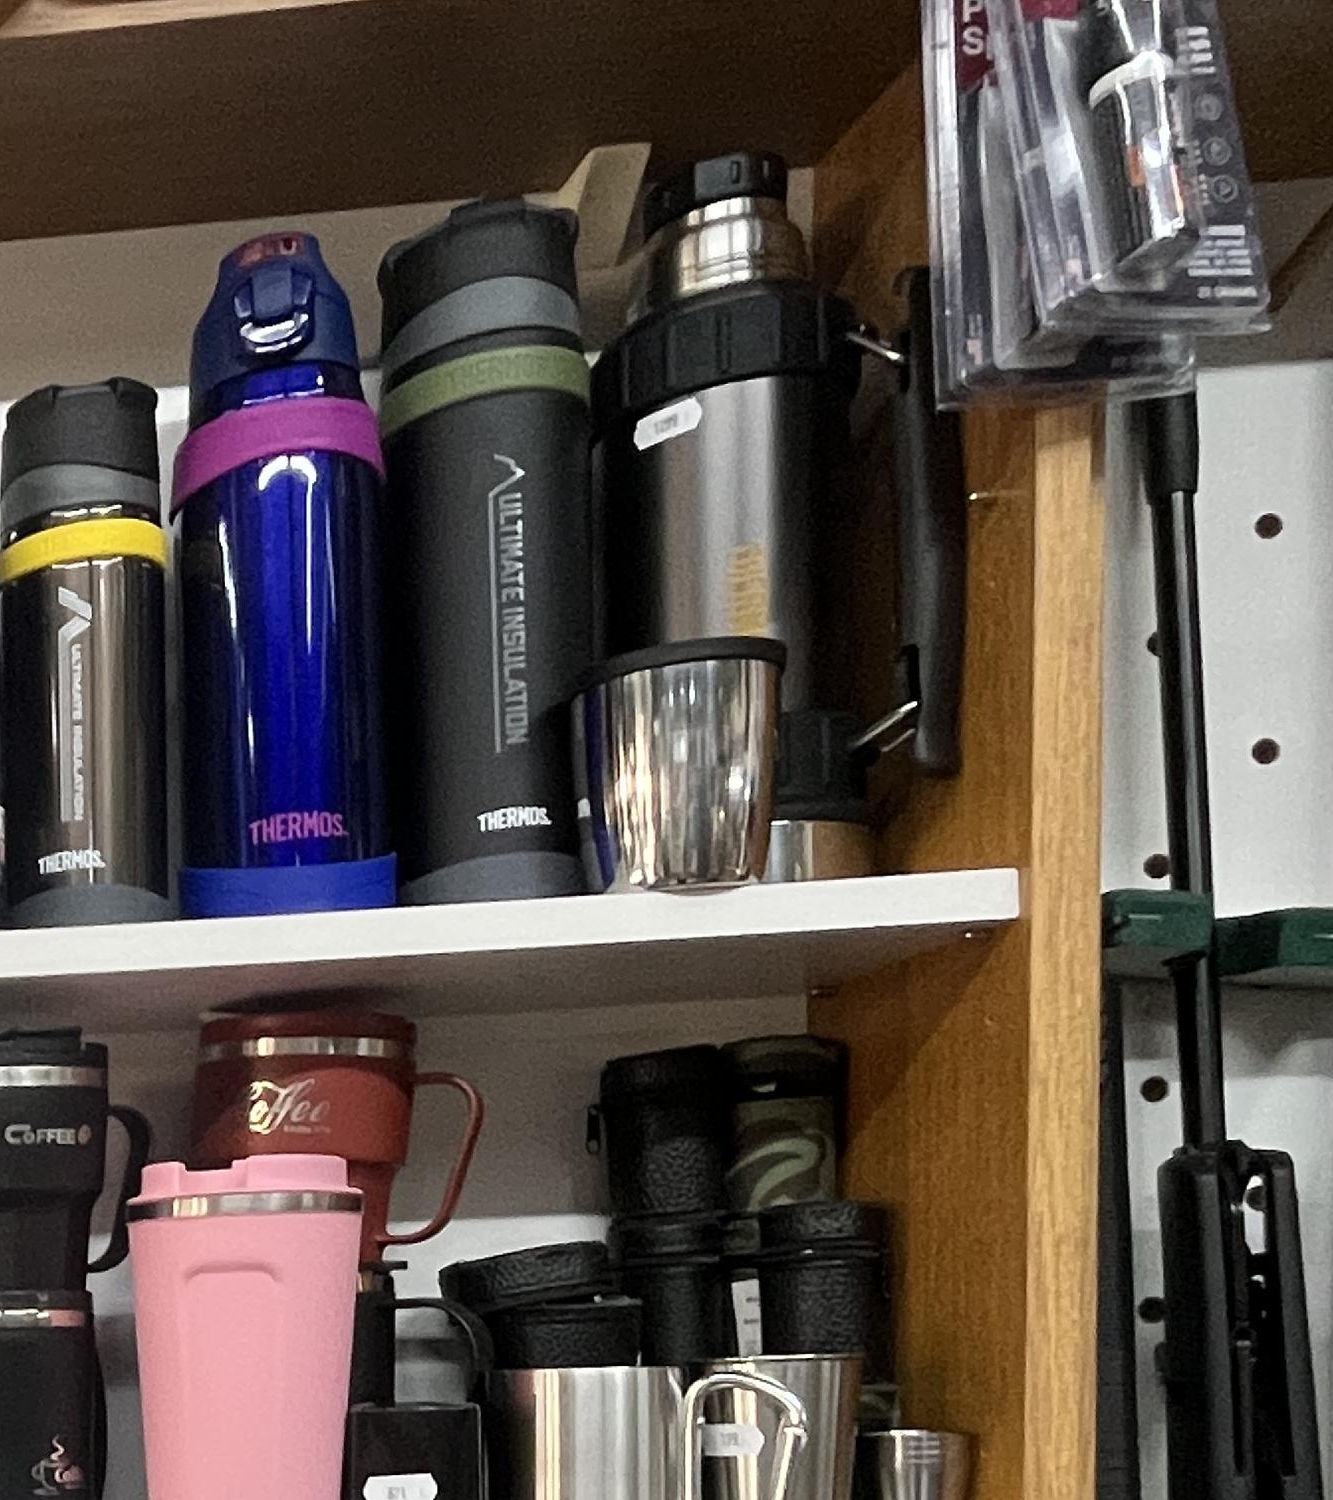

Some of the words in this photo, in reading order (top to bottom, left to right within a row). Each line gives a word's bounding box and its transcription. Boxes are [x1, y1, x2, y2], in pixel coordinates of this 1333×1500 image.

[499, 491, 526, 602] ULTIMATE
[502, 604, 529, 746] INSULATION
[248, 811, 349, 847] THERMOS
[476, 805, 552, 833] THERMOS
[37, 848, 106, 876] THERMOS
